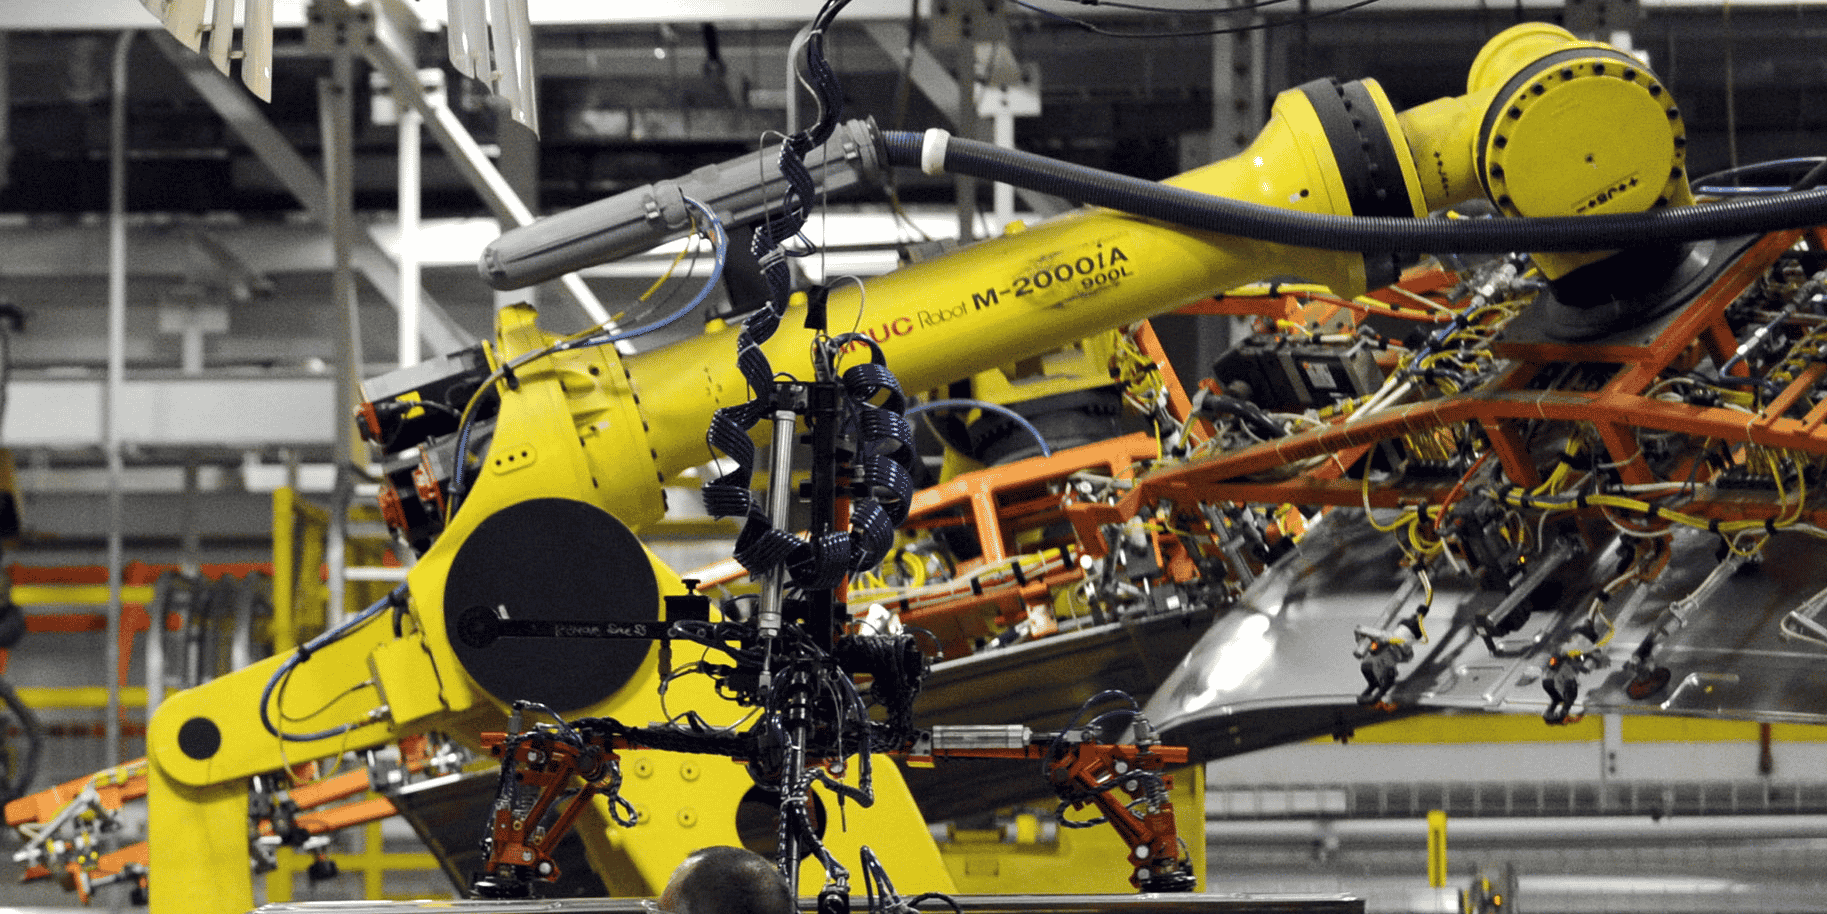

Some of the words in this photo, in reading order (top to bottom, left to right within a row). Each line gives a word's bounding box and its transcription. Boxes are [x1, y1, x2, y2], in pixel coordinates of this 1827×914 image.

[917, 300, 968, 329] Robot
[972, 242, 1128, 310] M-2000iA
[1081, 266, 1133, 289] 900L
